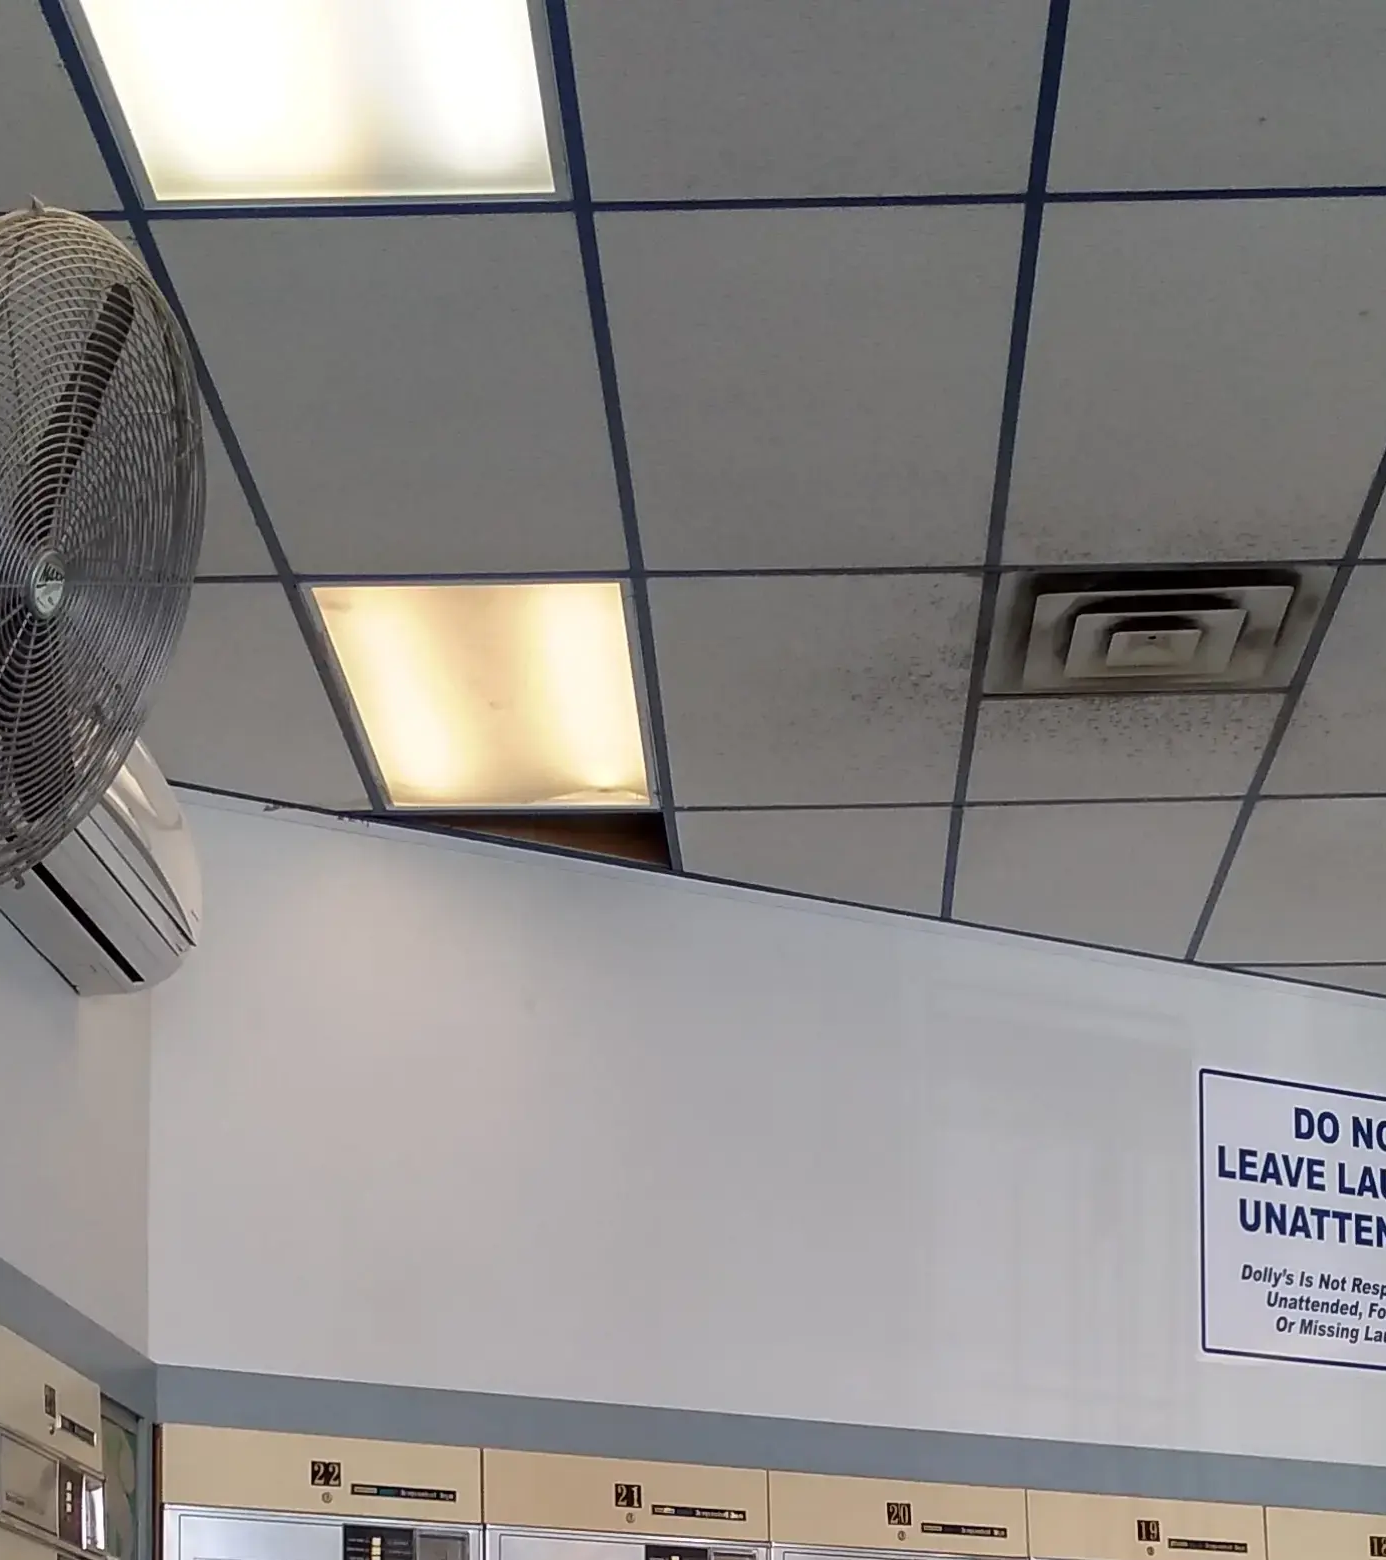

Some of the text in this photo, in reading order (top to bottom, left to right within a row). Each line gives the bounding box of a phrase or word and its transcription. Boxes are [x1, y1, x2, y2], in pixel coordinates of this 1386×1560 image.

[1294, 1107, 1340, 1144] DO
[1217, 1145, 1326, 1191] LEAVE
[1241, 1264, 1294, 1288] Dolly's
[1299, 1270, 1313, 1288] Is
[1318, 1273, 1346, 1292] Not
[1266, 1291, 1363, 1320] Unattended,
[1275, 1316, 1296, 1333] Or
[1299, 1318, 1359, 1343] Missing
[313, 1462, 341, 1486] 22
[617, 1483, 641, 1508] 21
[888, 1504, 910, 1526] 20
[1139, 1521, 1159, 1541] 19
